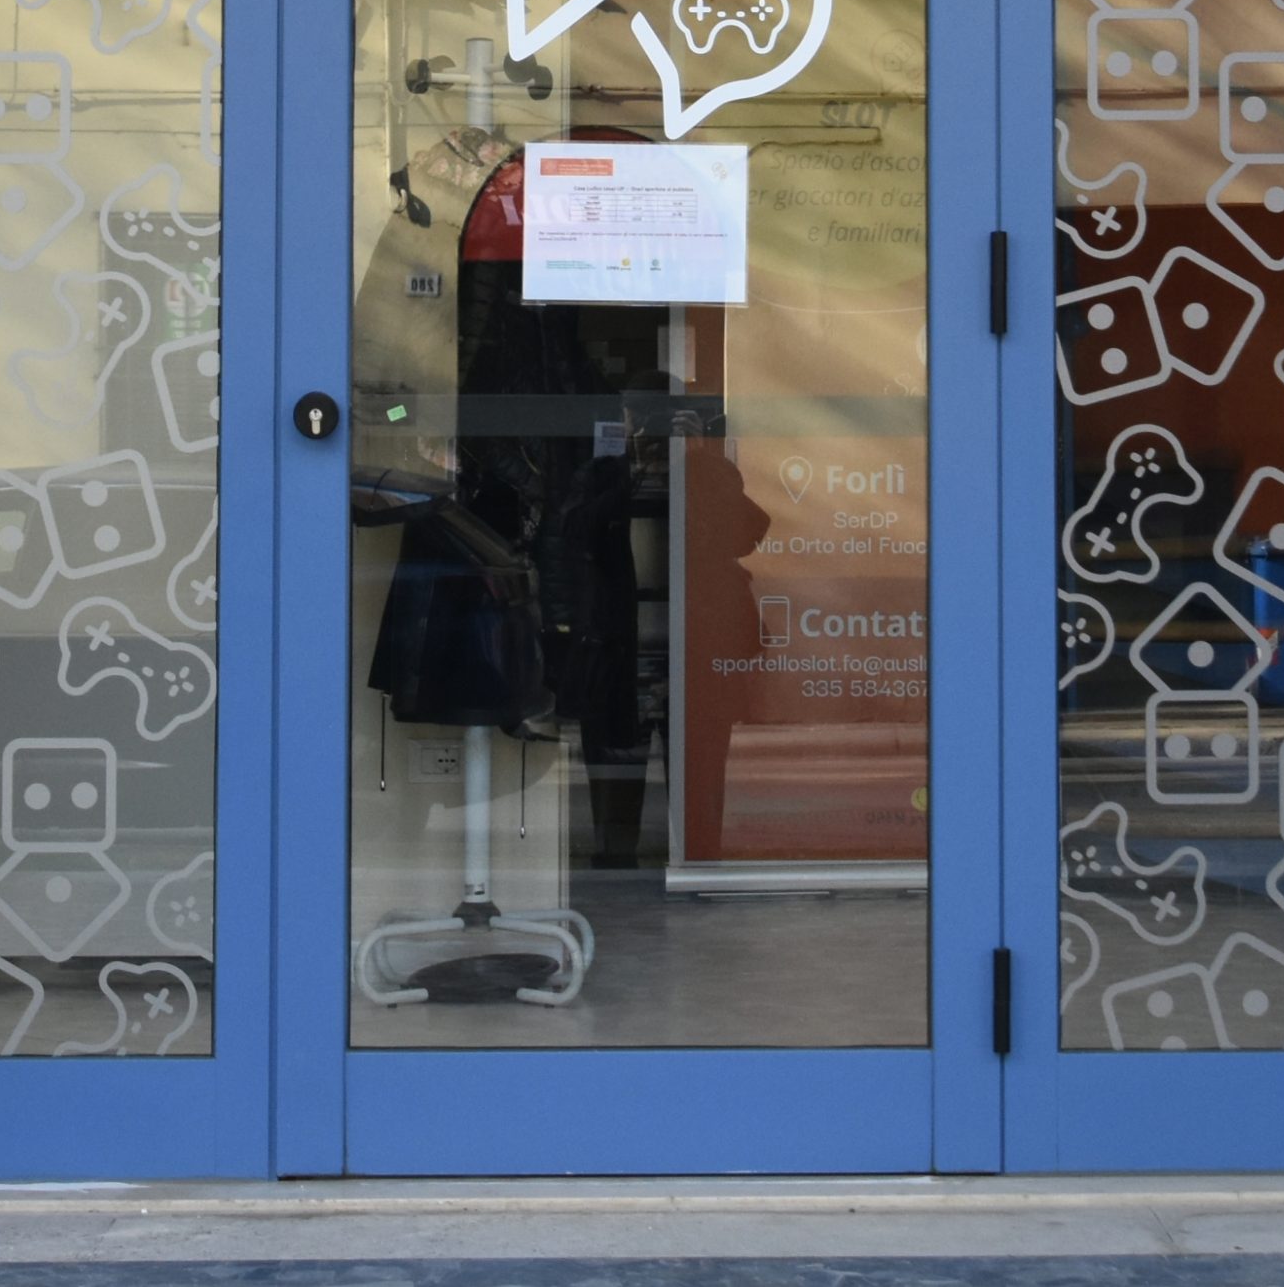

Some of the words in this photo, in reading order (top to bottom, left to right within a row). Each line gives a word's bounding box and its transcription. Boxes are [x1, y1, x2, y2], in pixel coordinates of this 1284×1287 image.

[819, 100, 897, 128] SLOT
[770, 150, 845, 176] Spazio
[851, 150, 926, 172] d'asco
[772, 188, 873, 211] giocatori
[807, 224, 820, 242] e
[826, 220, 921, 244] familiari
[827, 463, 907, 494] Forlì
[833, 511, 899, 529] SerDP
[754, 536, 784, 554] via
[789, 536, 835, 554] Orto
[842, 536, 872, 554] del
[800, 608, 927, 638] Contat
[801, 679, 843, 698] 335
